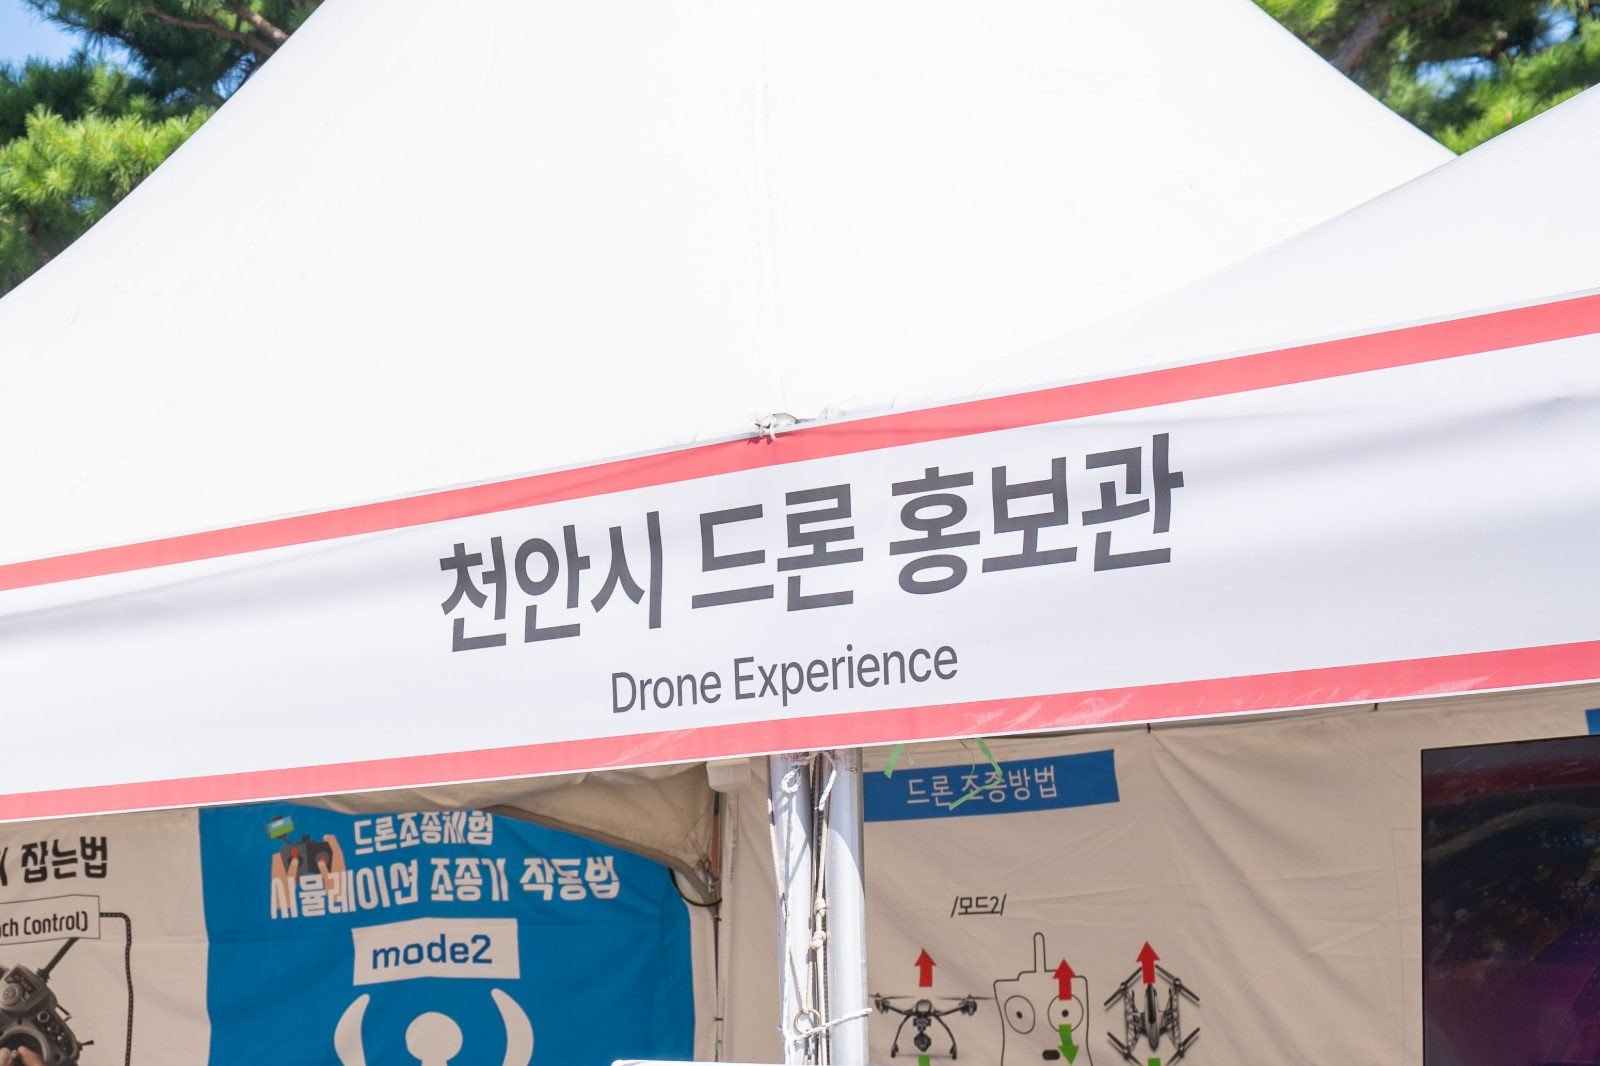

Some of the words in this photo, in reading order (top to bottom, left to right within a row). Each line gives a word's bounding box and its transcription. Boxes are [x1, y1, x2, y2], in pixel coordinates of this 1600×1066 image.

[439, 511, 663, 652] 천안시
[692, 483, 863, 611] 드론
[889, 433, 1184, 595] 홍보관
[611, 670, 722, 714] Drone
[735, 644, 958, 707] Experience
[907, 774, 953, 807] 드론
[21, 836, 108, 884] 잡는법
[270, 858, 419, 920] 시뮬레이션
[430, 857, 509, 902] 조종기
[519, 855, 621, 901] 작동법
[23, 910, 88, 936] Control)
[372, 933, 493, 970] mode2
